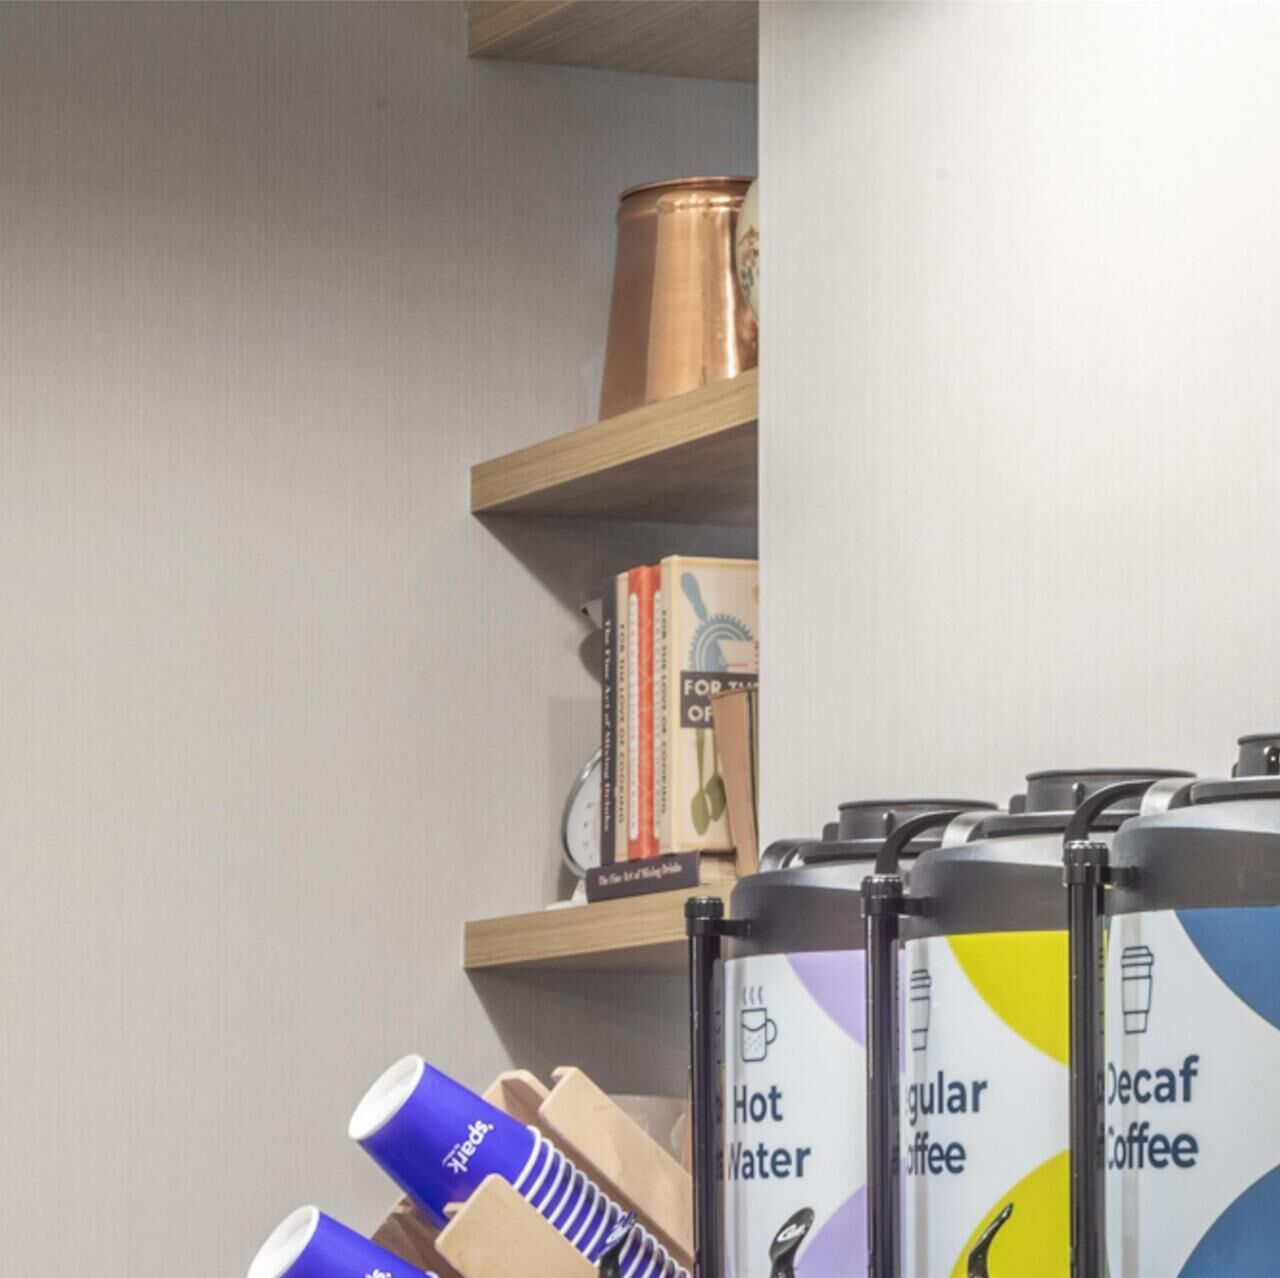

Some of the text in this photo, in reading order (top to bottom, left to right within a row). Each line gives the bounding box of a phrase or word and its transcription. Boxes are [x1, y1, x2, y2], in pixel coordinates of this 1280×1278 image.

[683, 678, 722, 696] FOR
[687, 704, 713, 722] OF
[733, 1084, 784, 1124] Hot
[907, 1070, 989, 1127] gular
[446, 1119, 493, 1175] spark
